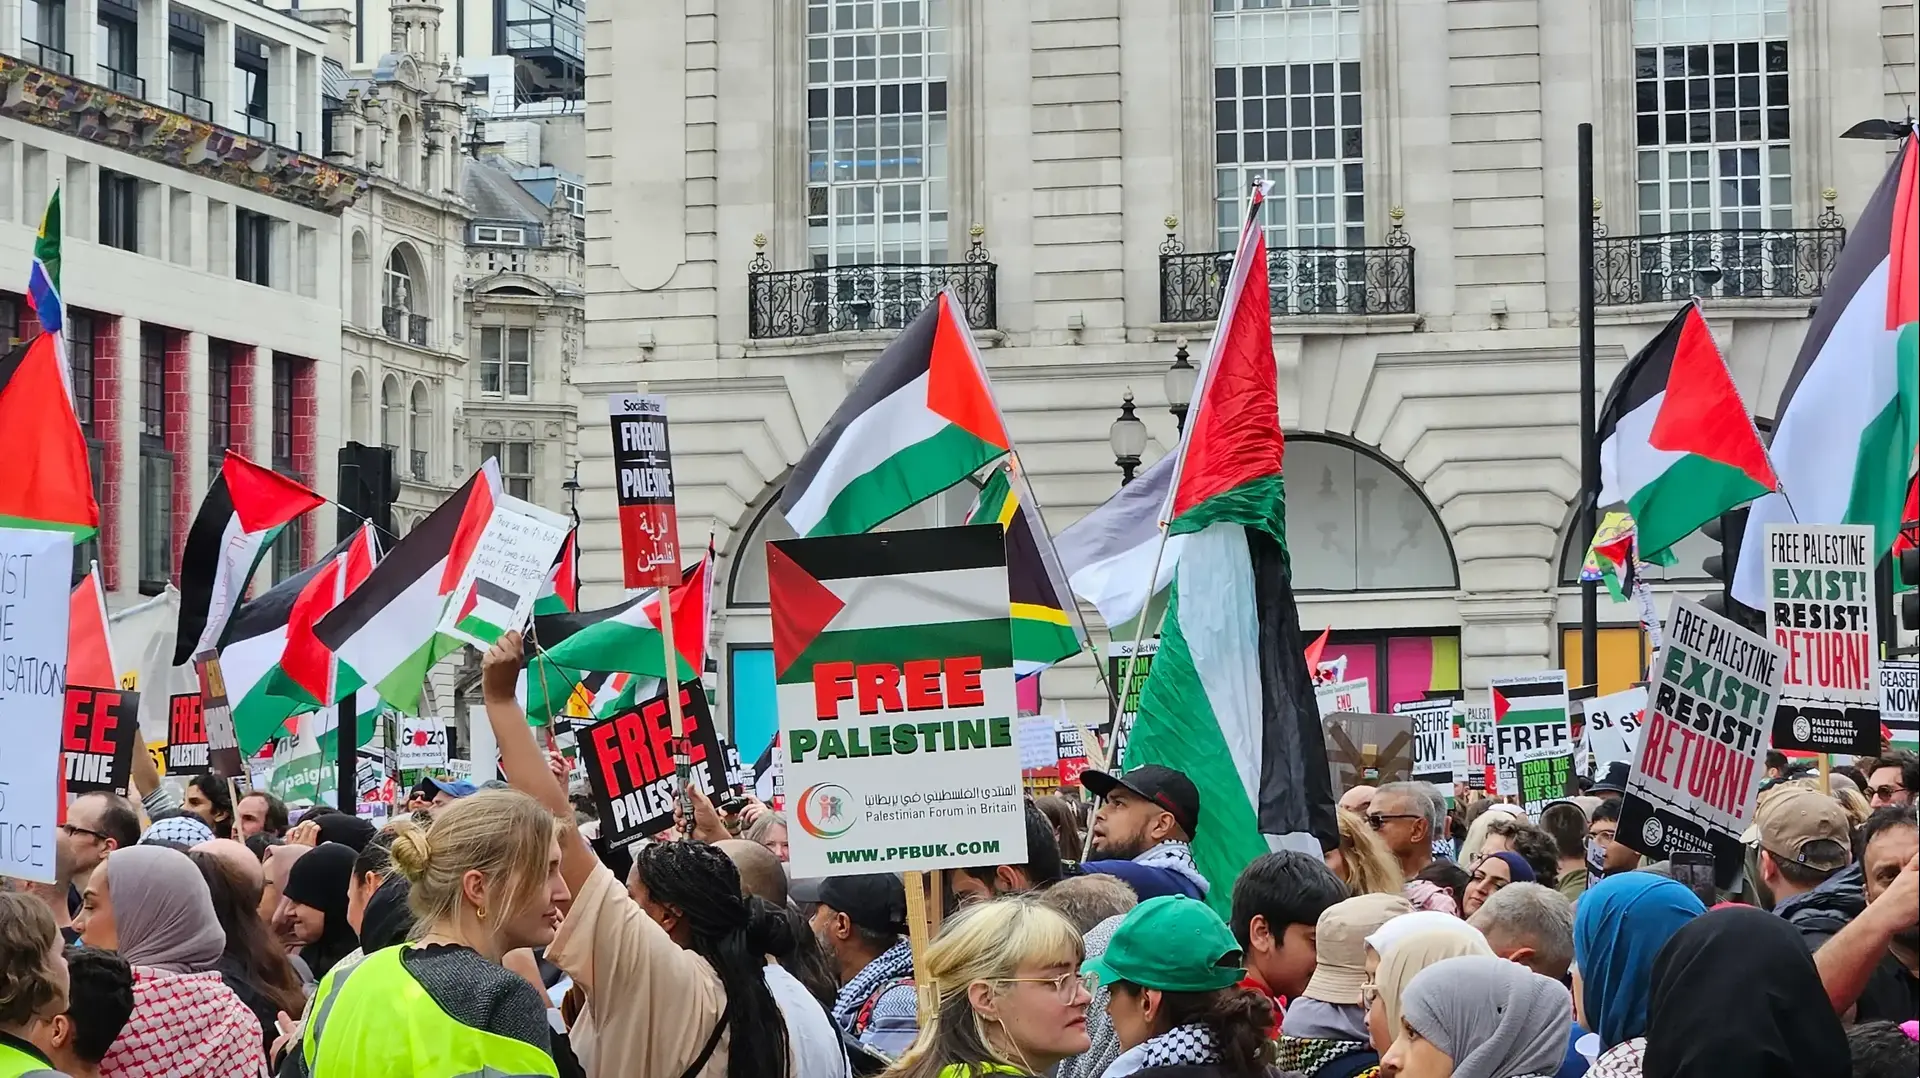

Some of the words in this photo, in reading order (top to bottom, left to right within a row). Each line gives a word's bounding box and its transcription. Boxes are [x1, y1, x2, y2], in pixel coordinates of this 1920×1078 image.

[1771, 533, 1800, 563] FREE
[1803, 533, 1866, 566] PALESTINE
[0, 552, 32, 599] IST
[1772, 568, 1867, 601] EXIST!
[1774, 602, 1868, 631] RESIST!
[1671, 606, 1706, 650] FREE
[1705, 621, 1778, 688] PALESTINE
[1775, 629, 1870, 691] RETURN!
[813, 655, 985, 720] FREE
[1662, 647, 1771, 726] EXIST!
[1880, 671, 1918, 688] CEASEFI
[1336, 693, 1351, 710] END
[1468, 708, 1492, 720] PALEST
[63, 689, 122, 754] EE
[1414, 710, 1449, 733] SEFIRE
[1654, 682, 1762, 757] RESIST!
[1811, 718, 1853, 728] PALESTINE
[1812, 727, 1858, 737] SOLIDARITY
[591, 688, 707, 799] FREE
[788, 717, 1012, 763] PALESTINE
[1059, 746, 1086, 758] PALEST
[1414, 732, 1445, 763] OW!
[1812, 735, 1854, 745] CAMPAIGN
[1522, 759, 1549, 776] FROM
[1552, 756, 1570, 770] THE
[1640, 711, 1755, 820] RETURN!
[1523, 772, 1551, 789] RIVER
[1554, 771, 1567, 784] TO
[1524, 788, 1543, 801] THE
[1545, 786, 1565, 799] SEA
[610, 760, 715, 833] PALESTNE
[900, 792, 921, 806] في
[866, 808, 925, 823] Palestinian
[929, 803, 964, 818] Forum
[967, 804, 977, 815] in
[980, 801, 1017, 814] Britain
[1667, 824, 1714, 852] PALESTINE
[827, 840, 1000, 866] WWW.PFBUK.COM
